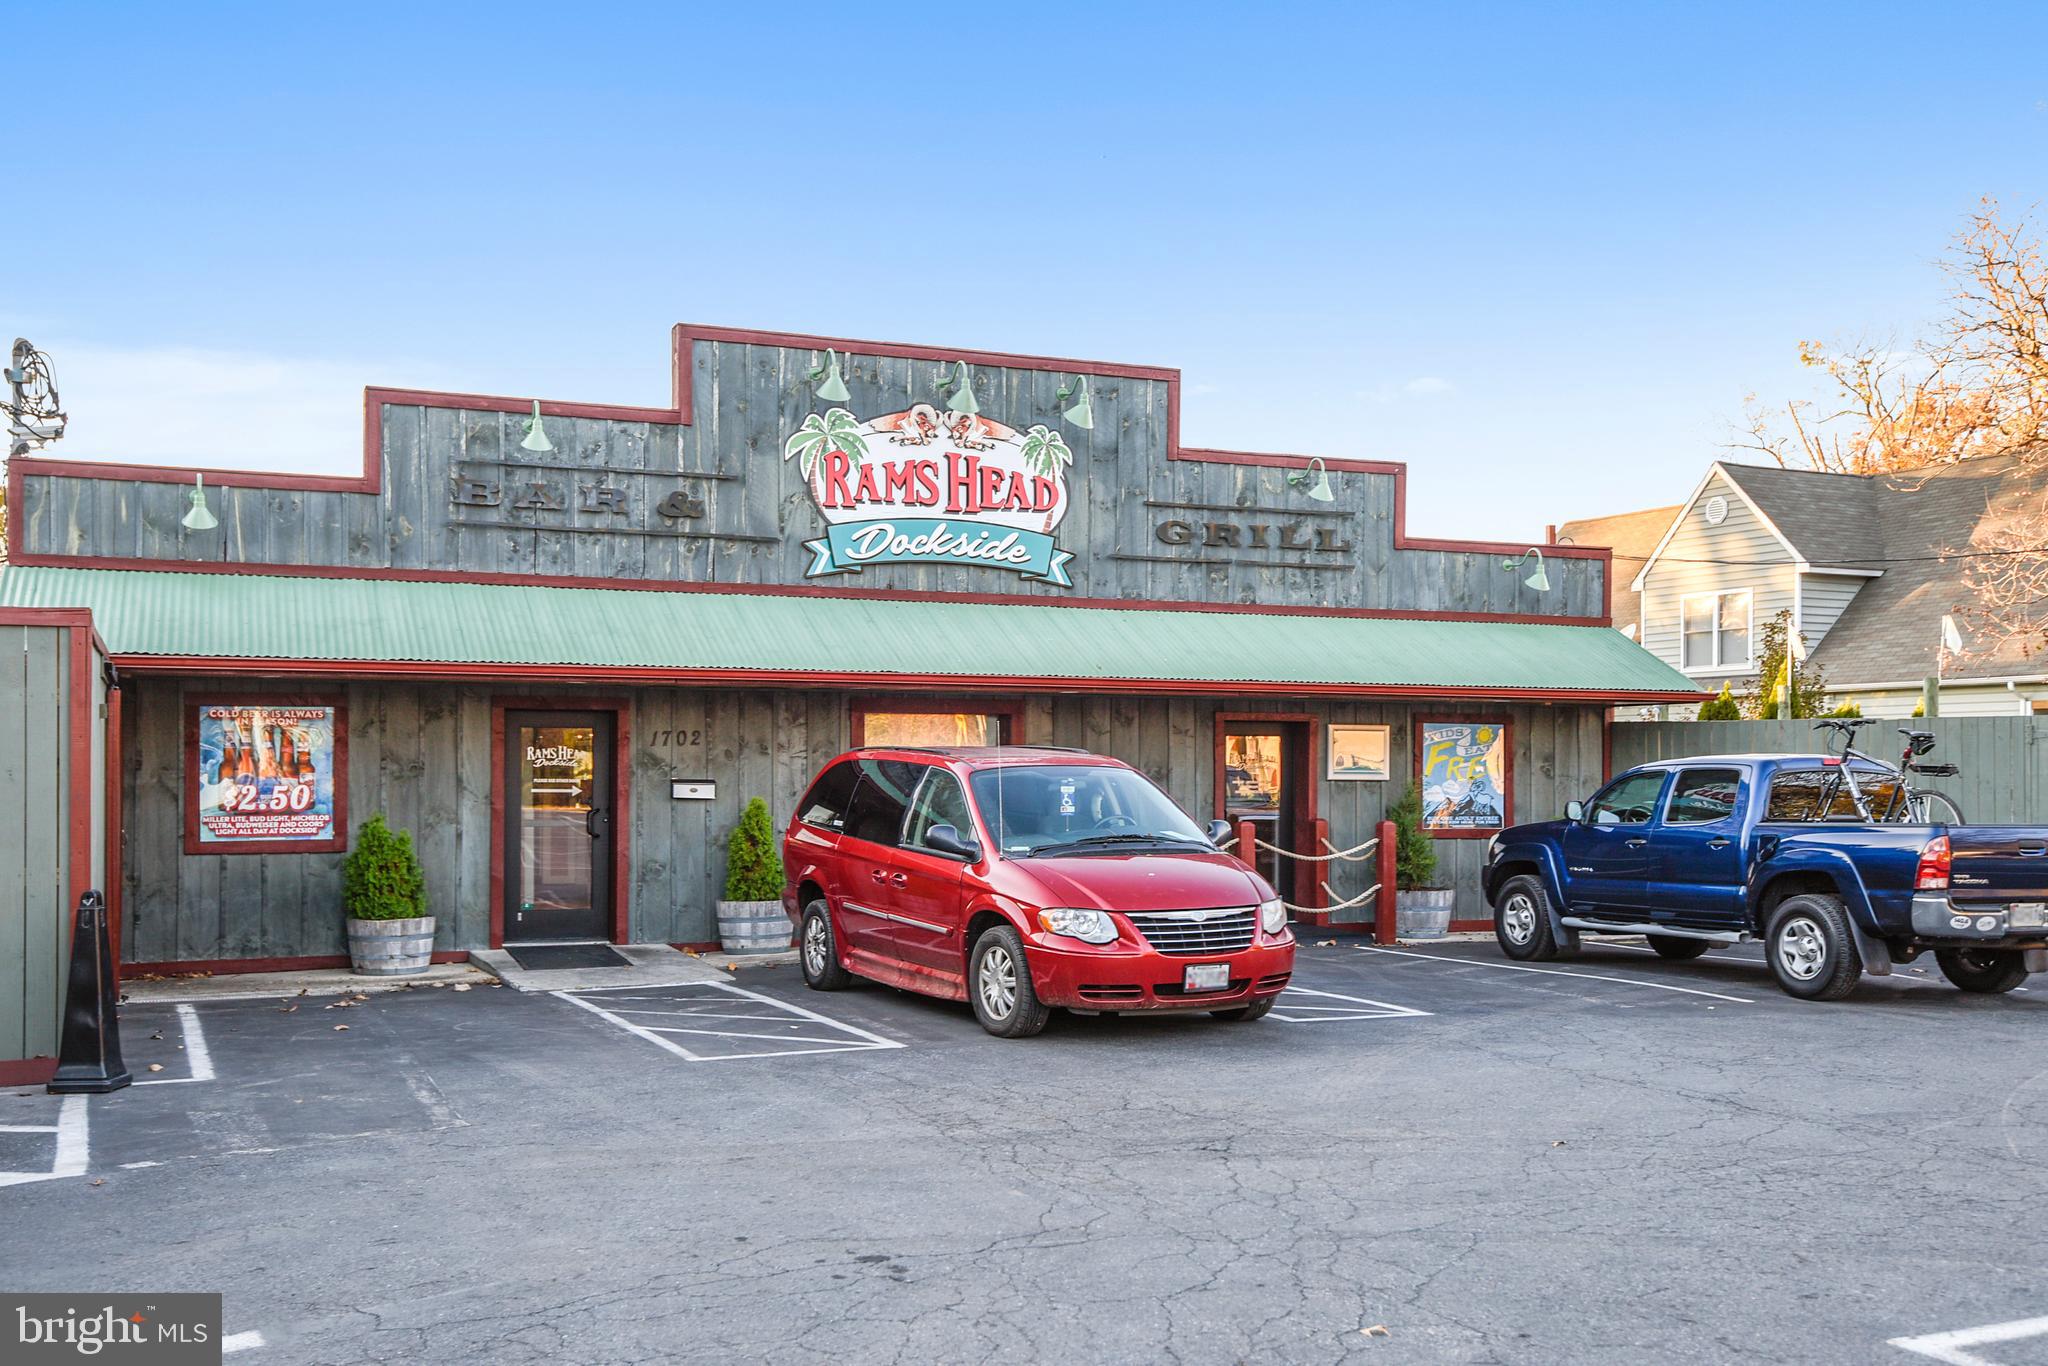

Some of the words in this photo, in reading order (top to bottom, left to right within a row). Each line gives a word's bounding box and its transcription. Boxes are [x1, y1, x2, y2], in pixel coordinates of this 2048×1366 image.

[823, 449, 941, 508] RAMS
[943, 451, 1060, 514] HEAD
[451, 476, 630, 514] BAR
[656, 490, 705, 518] &
[844, 523, 1032, 563] Dockside
[1156, 519, 1354, 552] GRILL
[209, 710, 239, 718] COLD
[272, 710, 281, 718] IS
[284, 710, 324, 718] ALWAYS
[650, 730, 700, 747] 1702
[526, 746, 557, 761] RAMS
[532, 757, 580, 768] Dockside
[223, 785, 311, 812] $2.50
